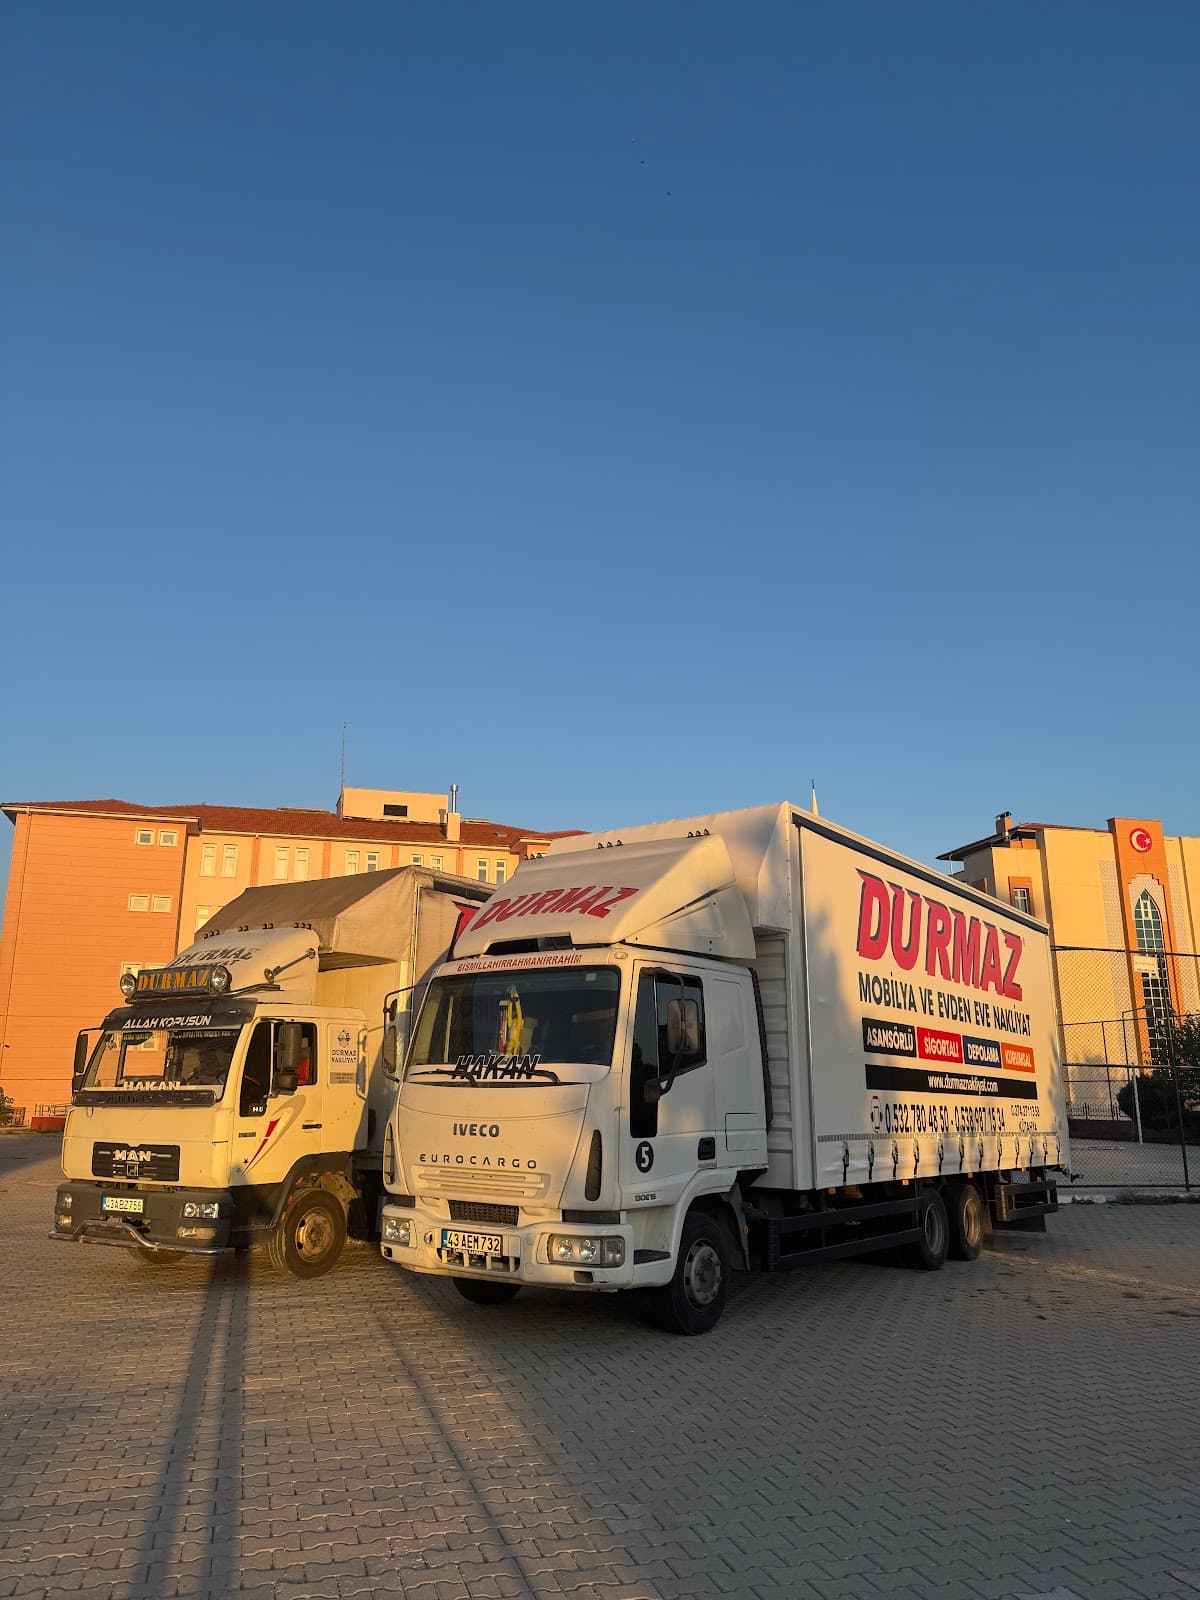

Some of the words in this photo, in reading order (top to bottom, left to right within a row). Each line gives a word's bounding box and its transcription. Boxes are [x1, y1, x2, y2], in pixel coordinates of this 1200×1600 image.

[470, 885, 640, 932] DURMAZ
[855, 868, 1023, 1002] DURMAZ
[137, 969, 209, 991] DURMAZ
[858, 972, 918, 1013] MOBİLYA
[918, 986, 934, 1016] VE
[938, 991, 972, 1024] EVDEN
[974, 1000, 991, 1028] EVE
[992, 1004, 1032, 1036] NAKLİYAT
[122, 1017, 158, 1029] ALLAH
[867, 1025, 914, 1051] ASANSÖRLÜ
[923, 1032, 960, 1058] SİGORTALI
[967, 1043, 1000, 1064] DEPOLAMA
[451, 1054, 541, 1080] HAKAN
[123, 1081, 181, 1091] HAKAN
[453, 1123, 500, 1138] IVECO
[113, 1150, 151, 1162] MAN
[419, 1153, 537, 1169] EUROCARGO
[640, 1146, 650, 1168] 5
